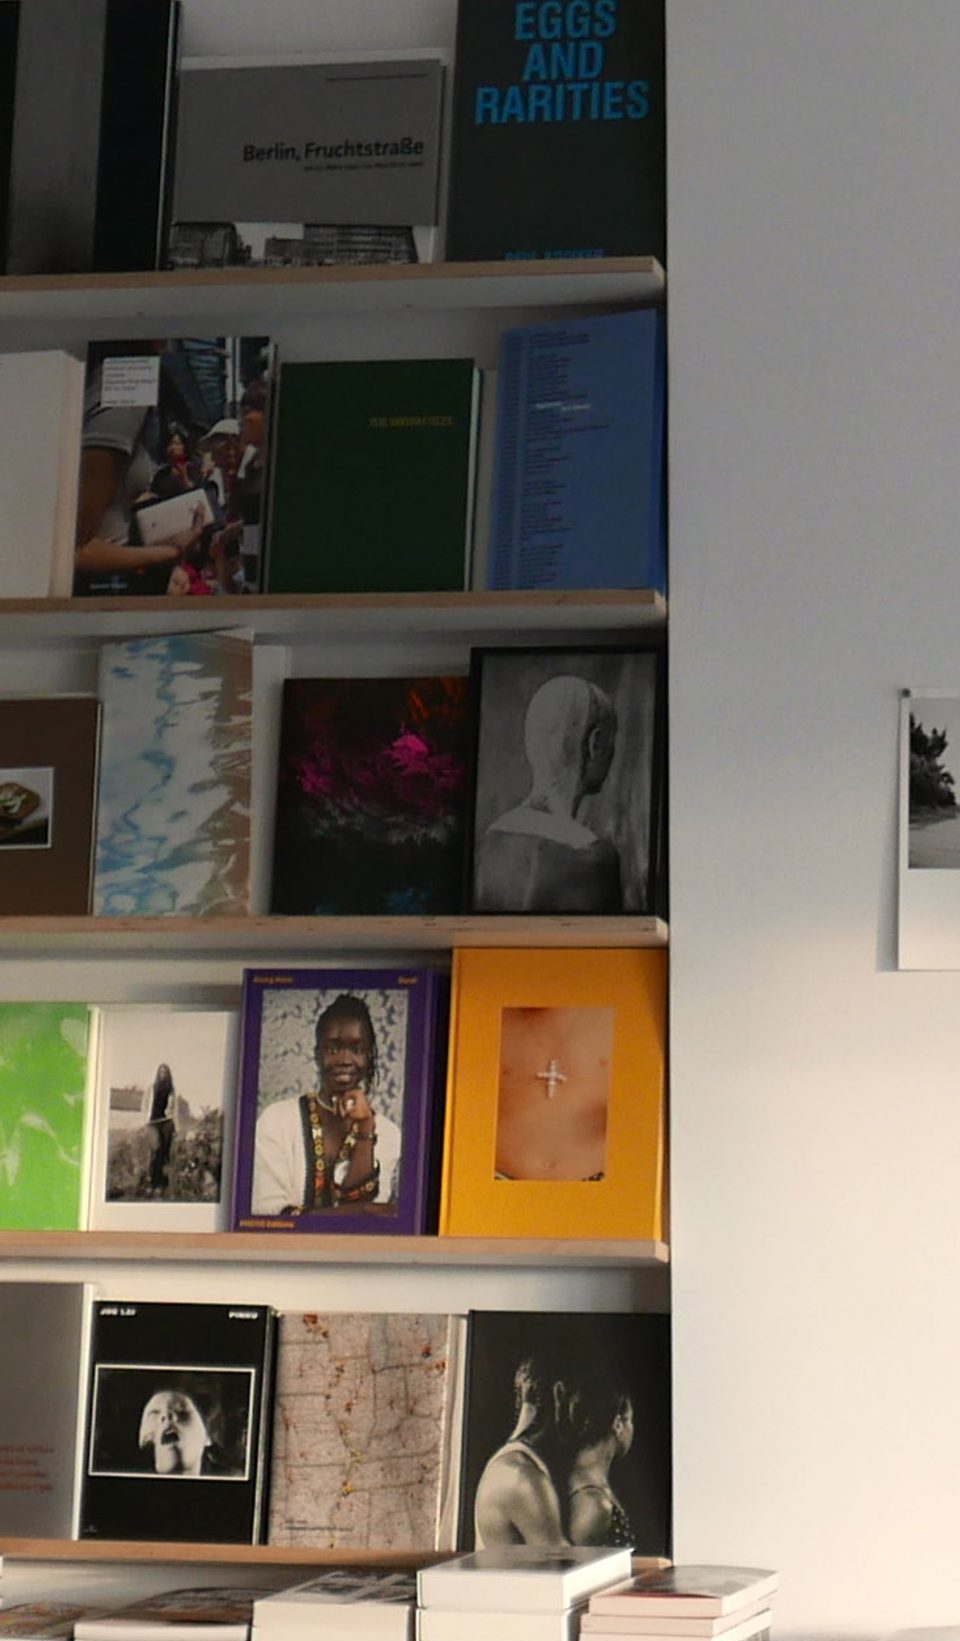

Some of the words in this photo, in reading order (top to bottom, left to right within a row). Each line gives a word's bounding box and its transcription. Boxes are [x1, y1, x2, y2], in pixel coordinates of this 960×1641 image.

[514, 1, 617, 41] EGGS
[523, 41, 603, 81] AND
[474, 80, 650, 125] RARITIES
[242, 142, 301, 162] Berlin,
[304, 136, 425, 160] Fruchtstraße
